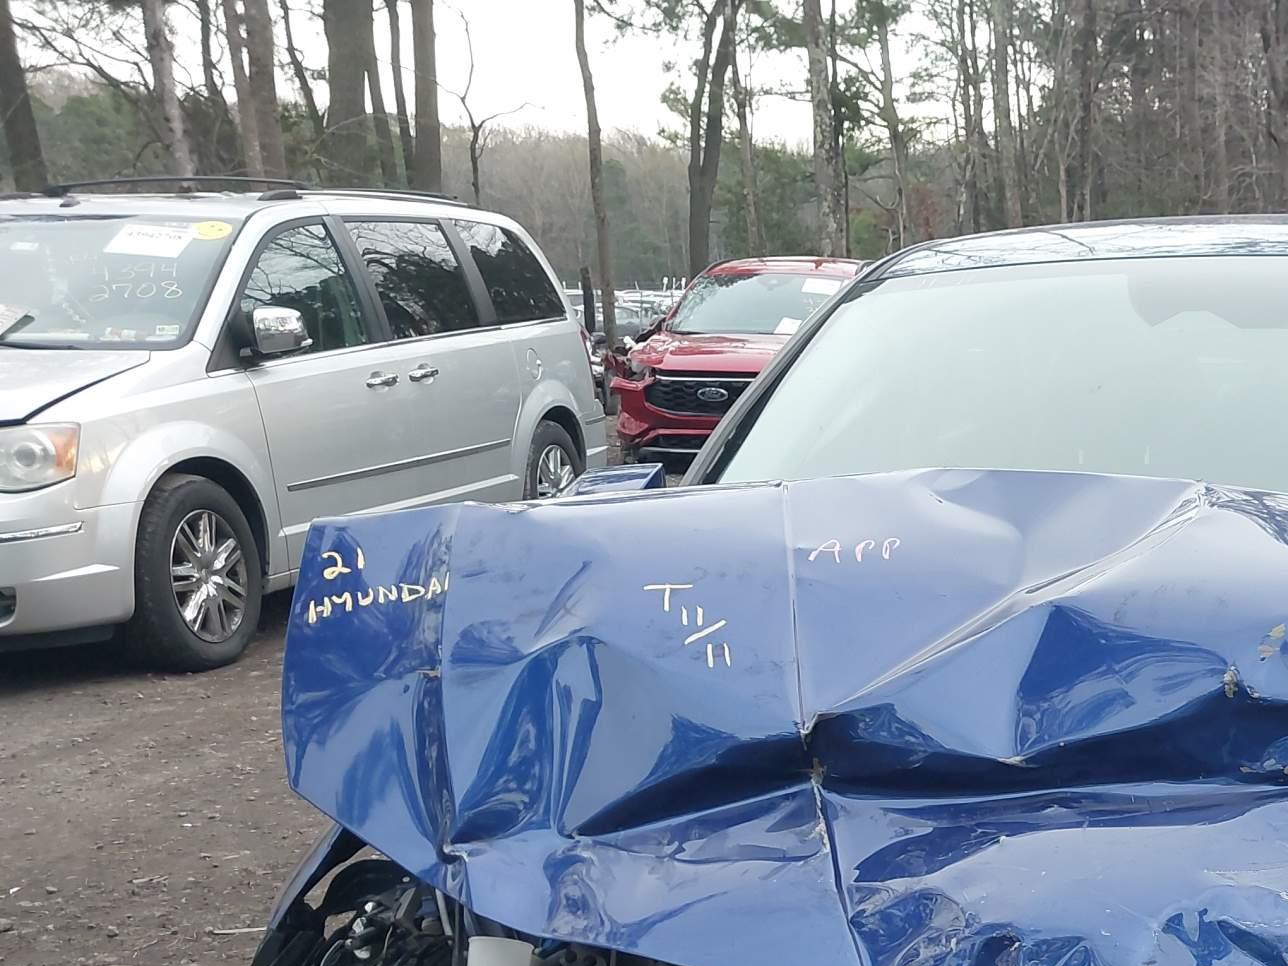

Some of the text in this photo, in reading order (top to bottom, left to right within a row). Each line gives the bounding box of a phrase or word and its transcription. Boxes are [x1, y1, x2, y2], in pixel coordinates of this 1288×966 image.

[88, 280, 184, 302] 2708
[321, 546, 366, 580] 21
[807, 537, 900, 563] APP
[308, 571, 450, 624] HYUNDAI
